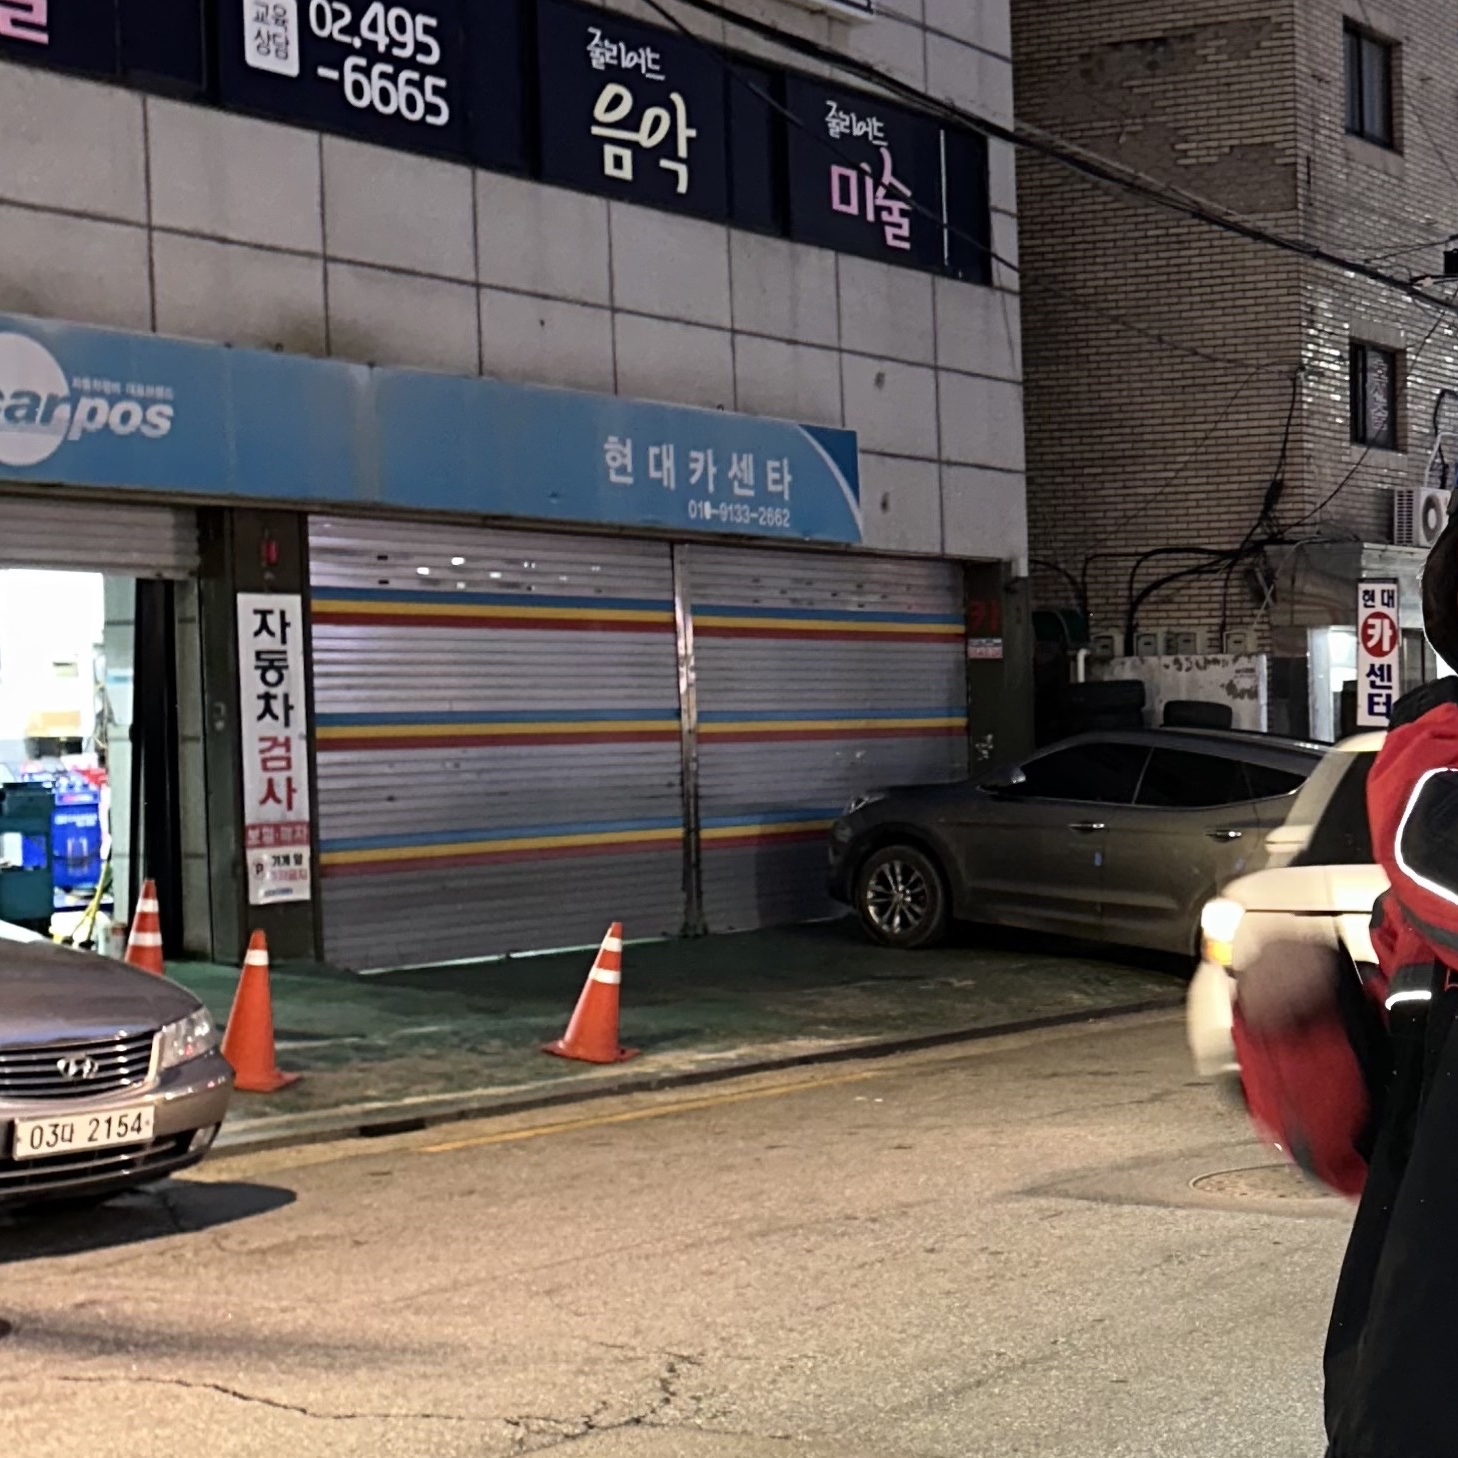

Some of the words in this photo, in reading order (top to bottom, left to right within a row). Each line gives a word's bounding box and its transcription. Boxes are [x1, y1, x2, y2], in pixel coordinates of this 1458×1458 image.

[252, 1, 288, 33] 교육
[253, 28, 290, 60] 상담
[309, 0, 440, 66] 02.495
[316, 55, 450, 126] -6665
[591, 83, 697, 195] 음악
[831, 146, 913, 250] 미술
[0, 387, 175, 441] arpos
[603, 435, 793, 501] 현대카센타
[1361, 588, 1395, 609] 현대
[1366, 618, 1393, 653] 카
[87, 1111, 143, 1142] 2154
